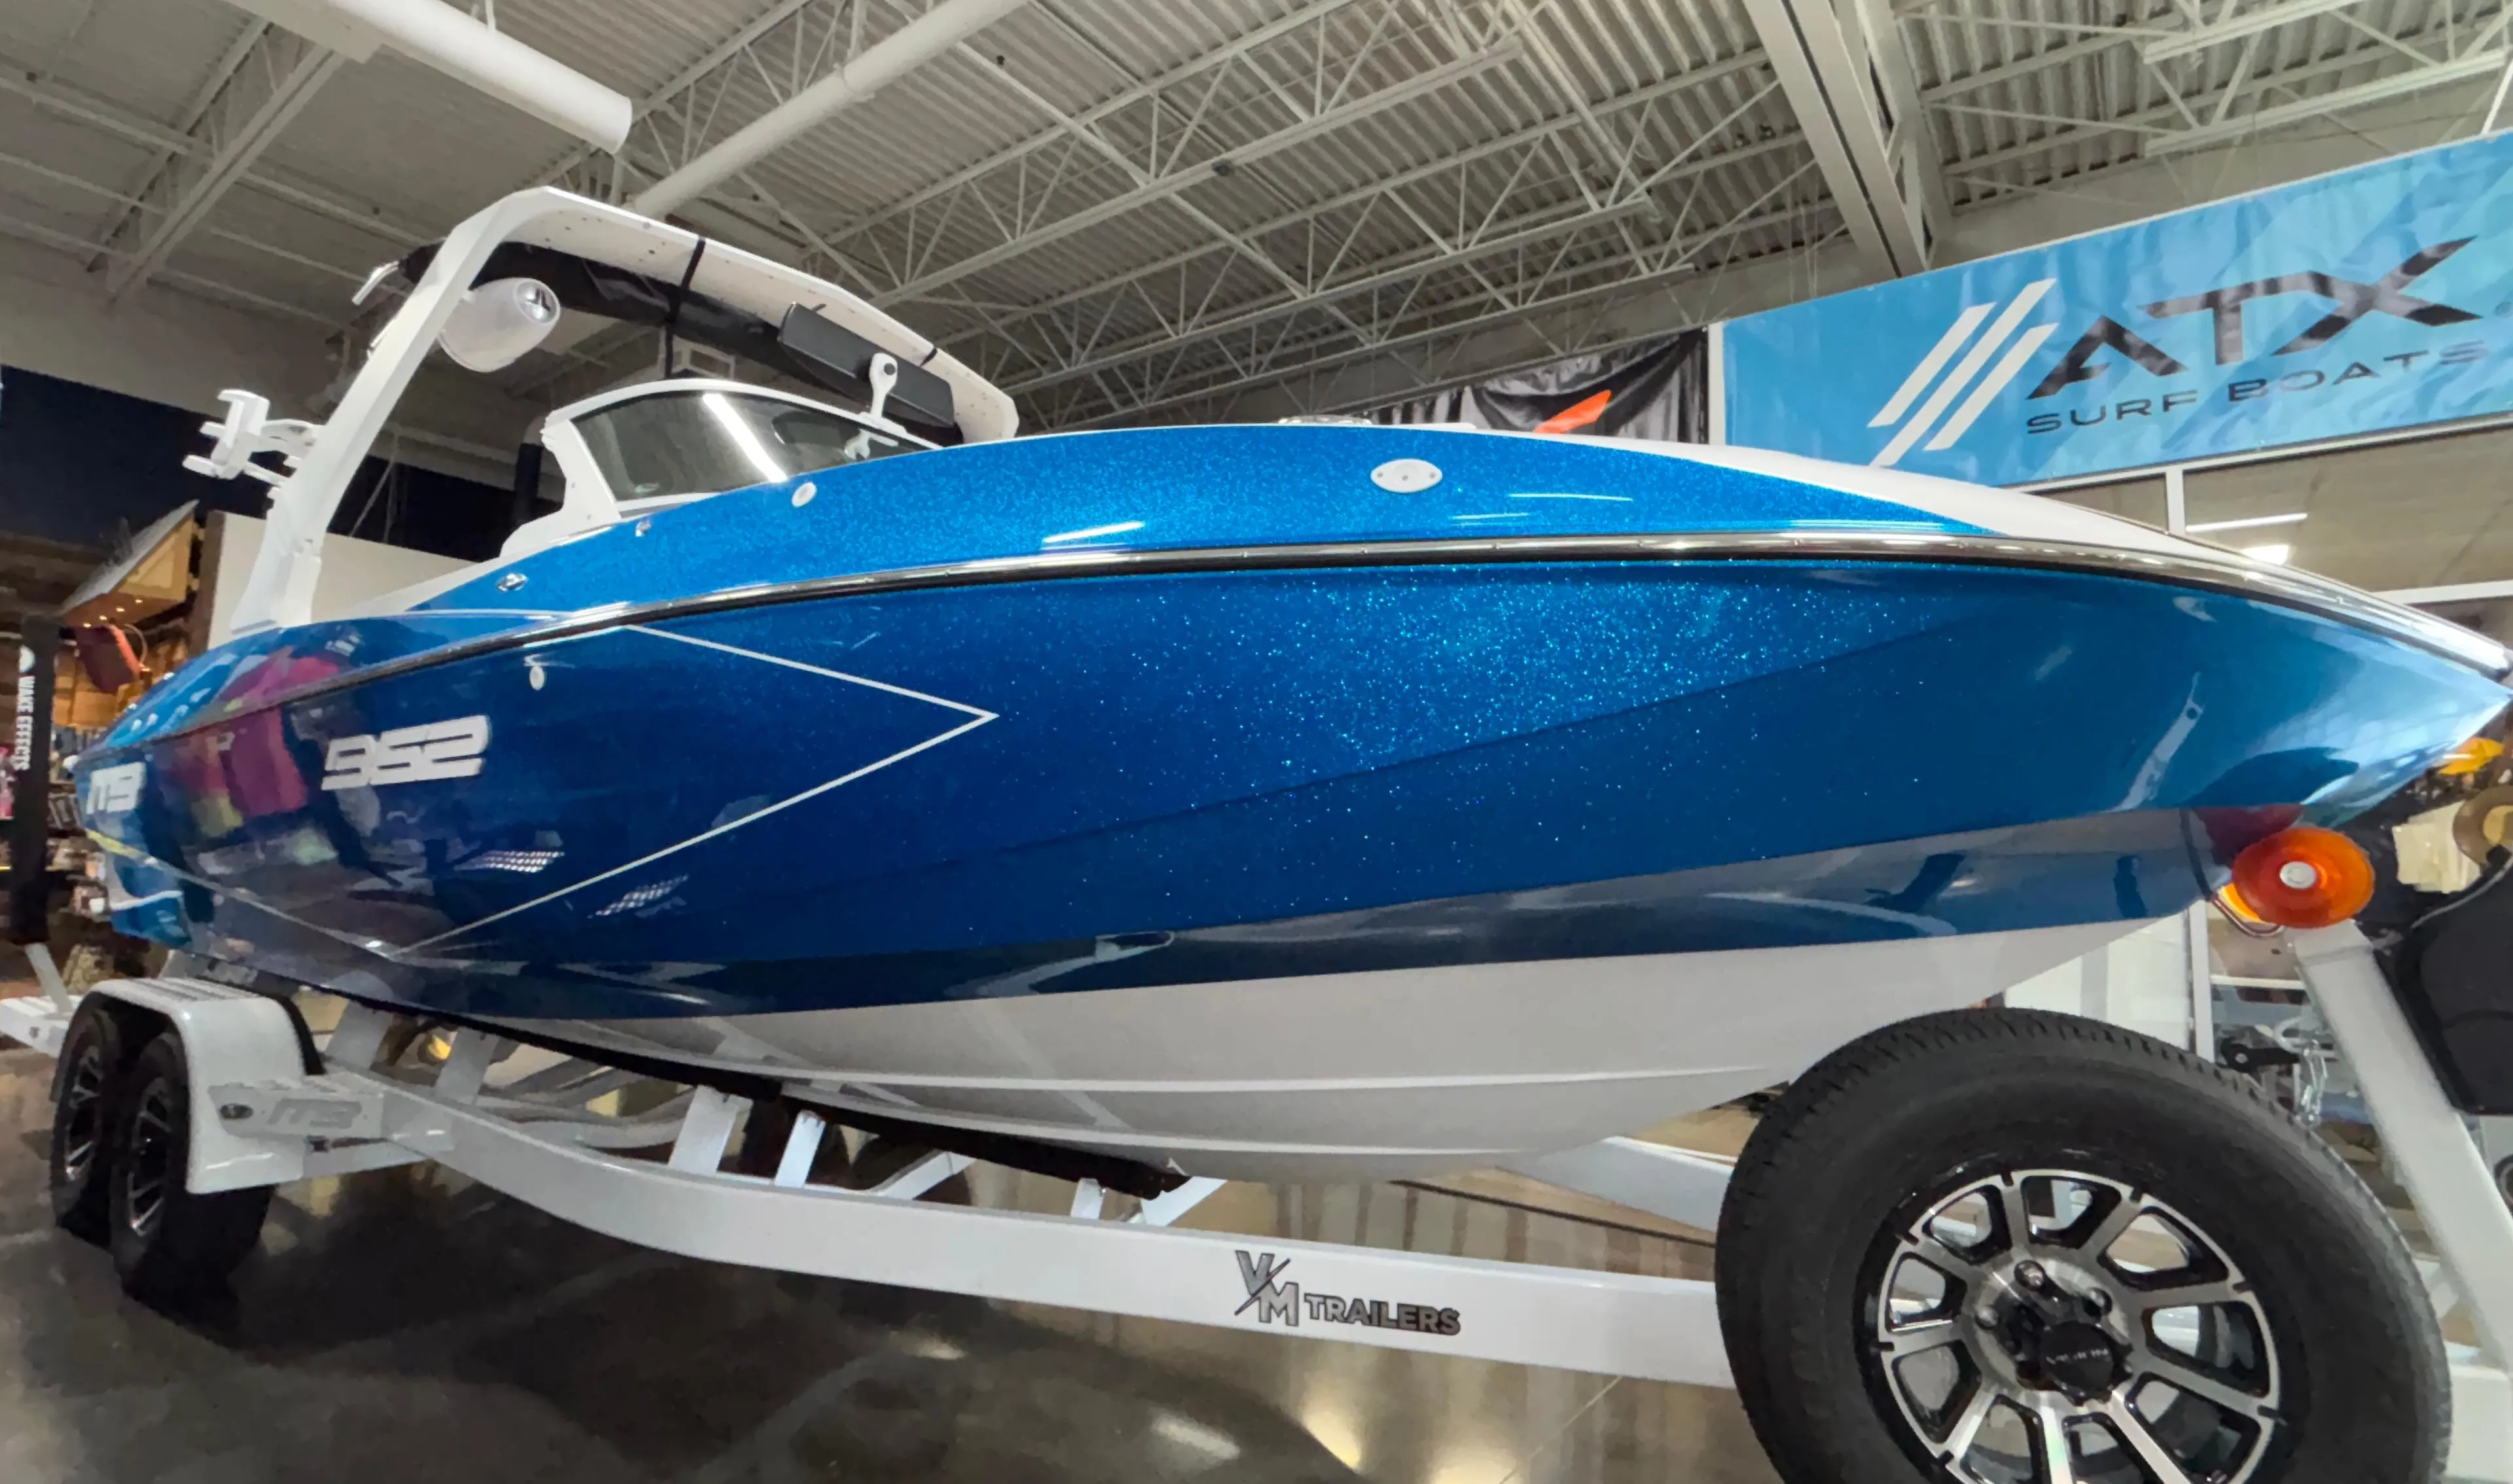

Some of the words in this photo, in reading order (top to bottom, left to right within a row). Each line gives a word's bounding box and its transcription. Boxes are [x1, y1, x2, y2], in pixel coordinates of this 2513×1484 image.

[2026, 236, 2483, 399] ATX
[2026, 390, 2198, 434] SURF
[2228, 340, 2486, 401] BOATS
[17, 676, 35, 713] WAKE
[10, 716, 33, 770] EFFECTS
[1304, 1293, 1461, 1335] TRAILERS
